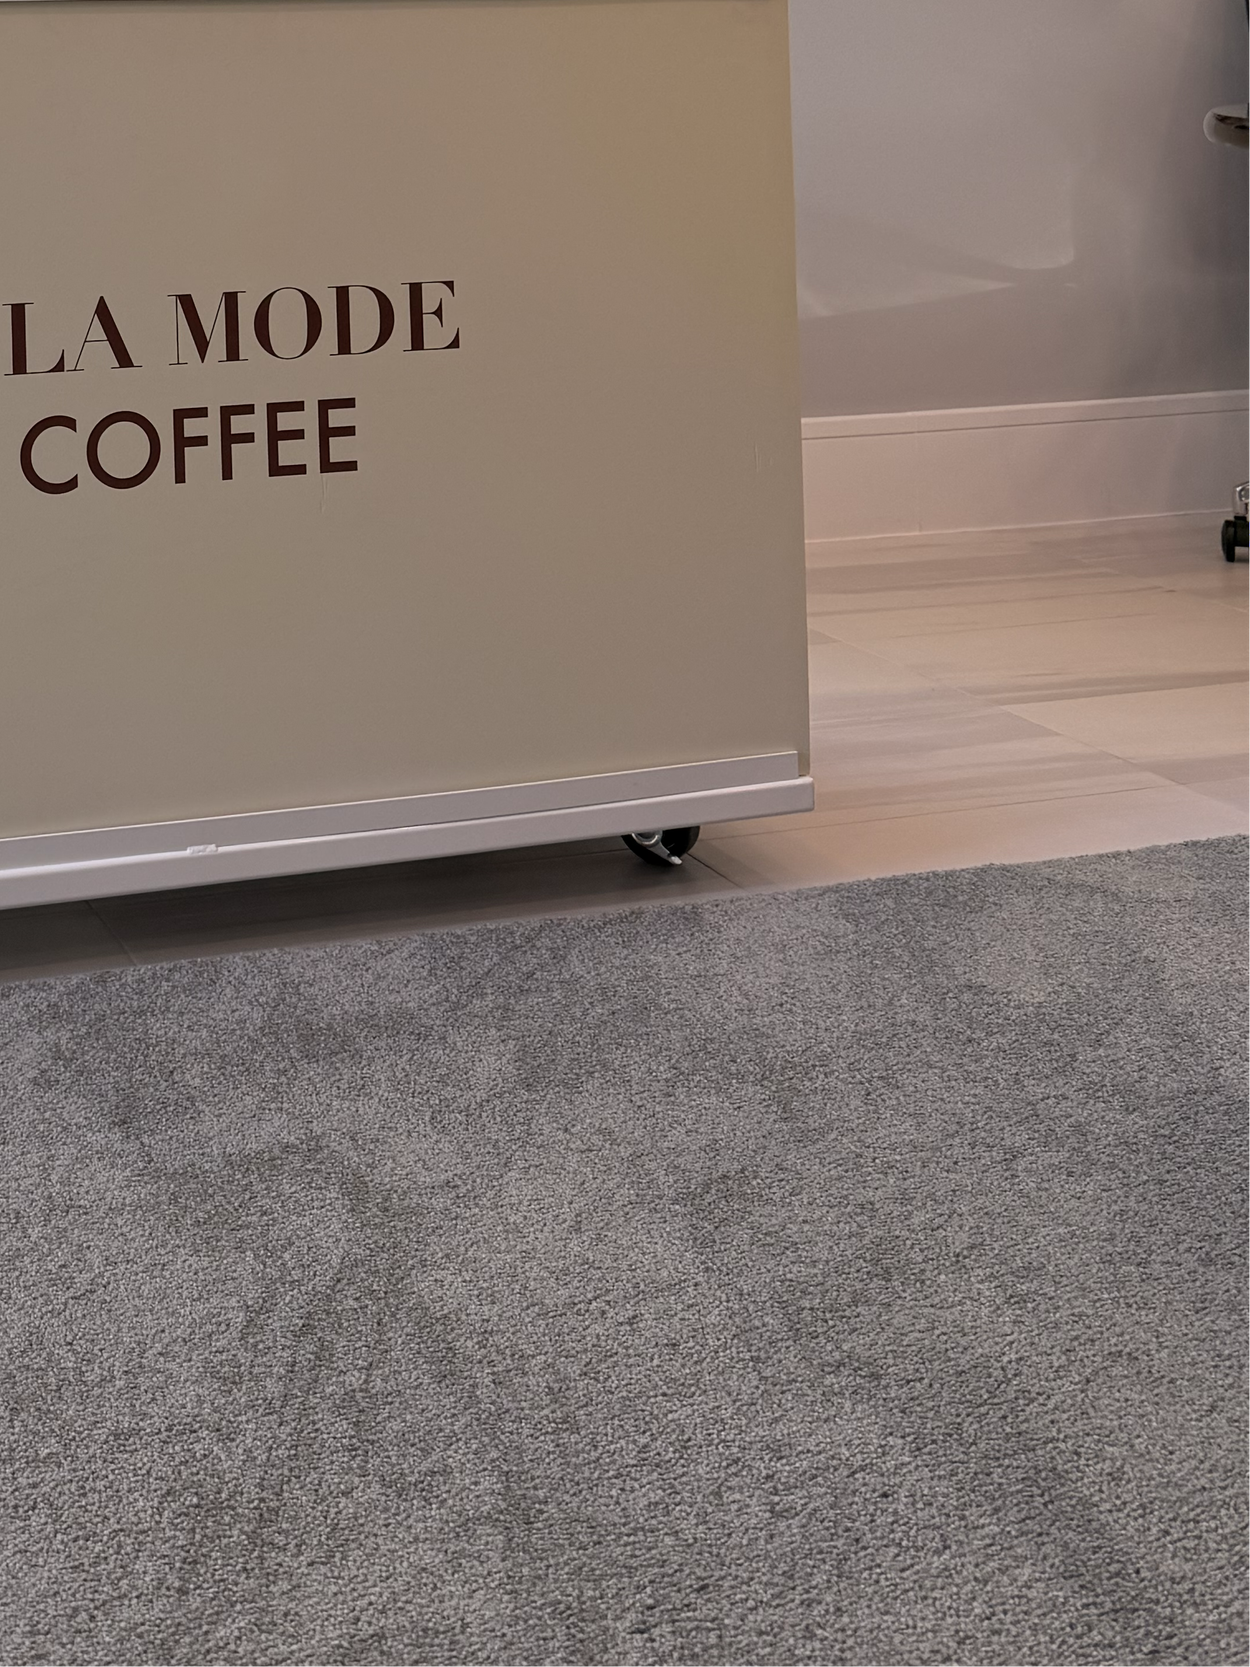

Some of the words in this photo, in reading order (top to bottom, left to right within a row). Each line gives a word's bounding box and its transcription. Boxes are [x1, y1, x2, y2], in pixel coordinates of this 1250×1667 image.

[2, 295, 143, 376] LA
[167, 280, 461, 366] MODE
[19, 397, 358, 495] COFFEE
